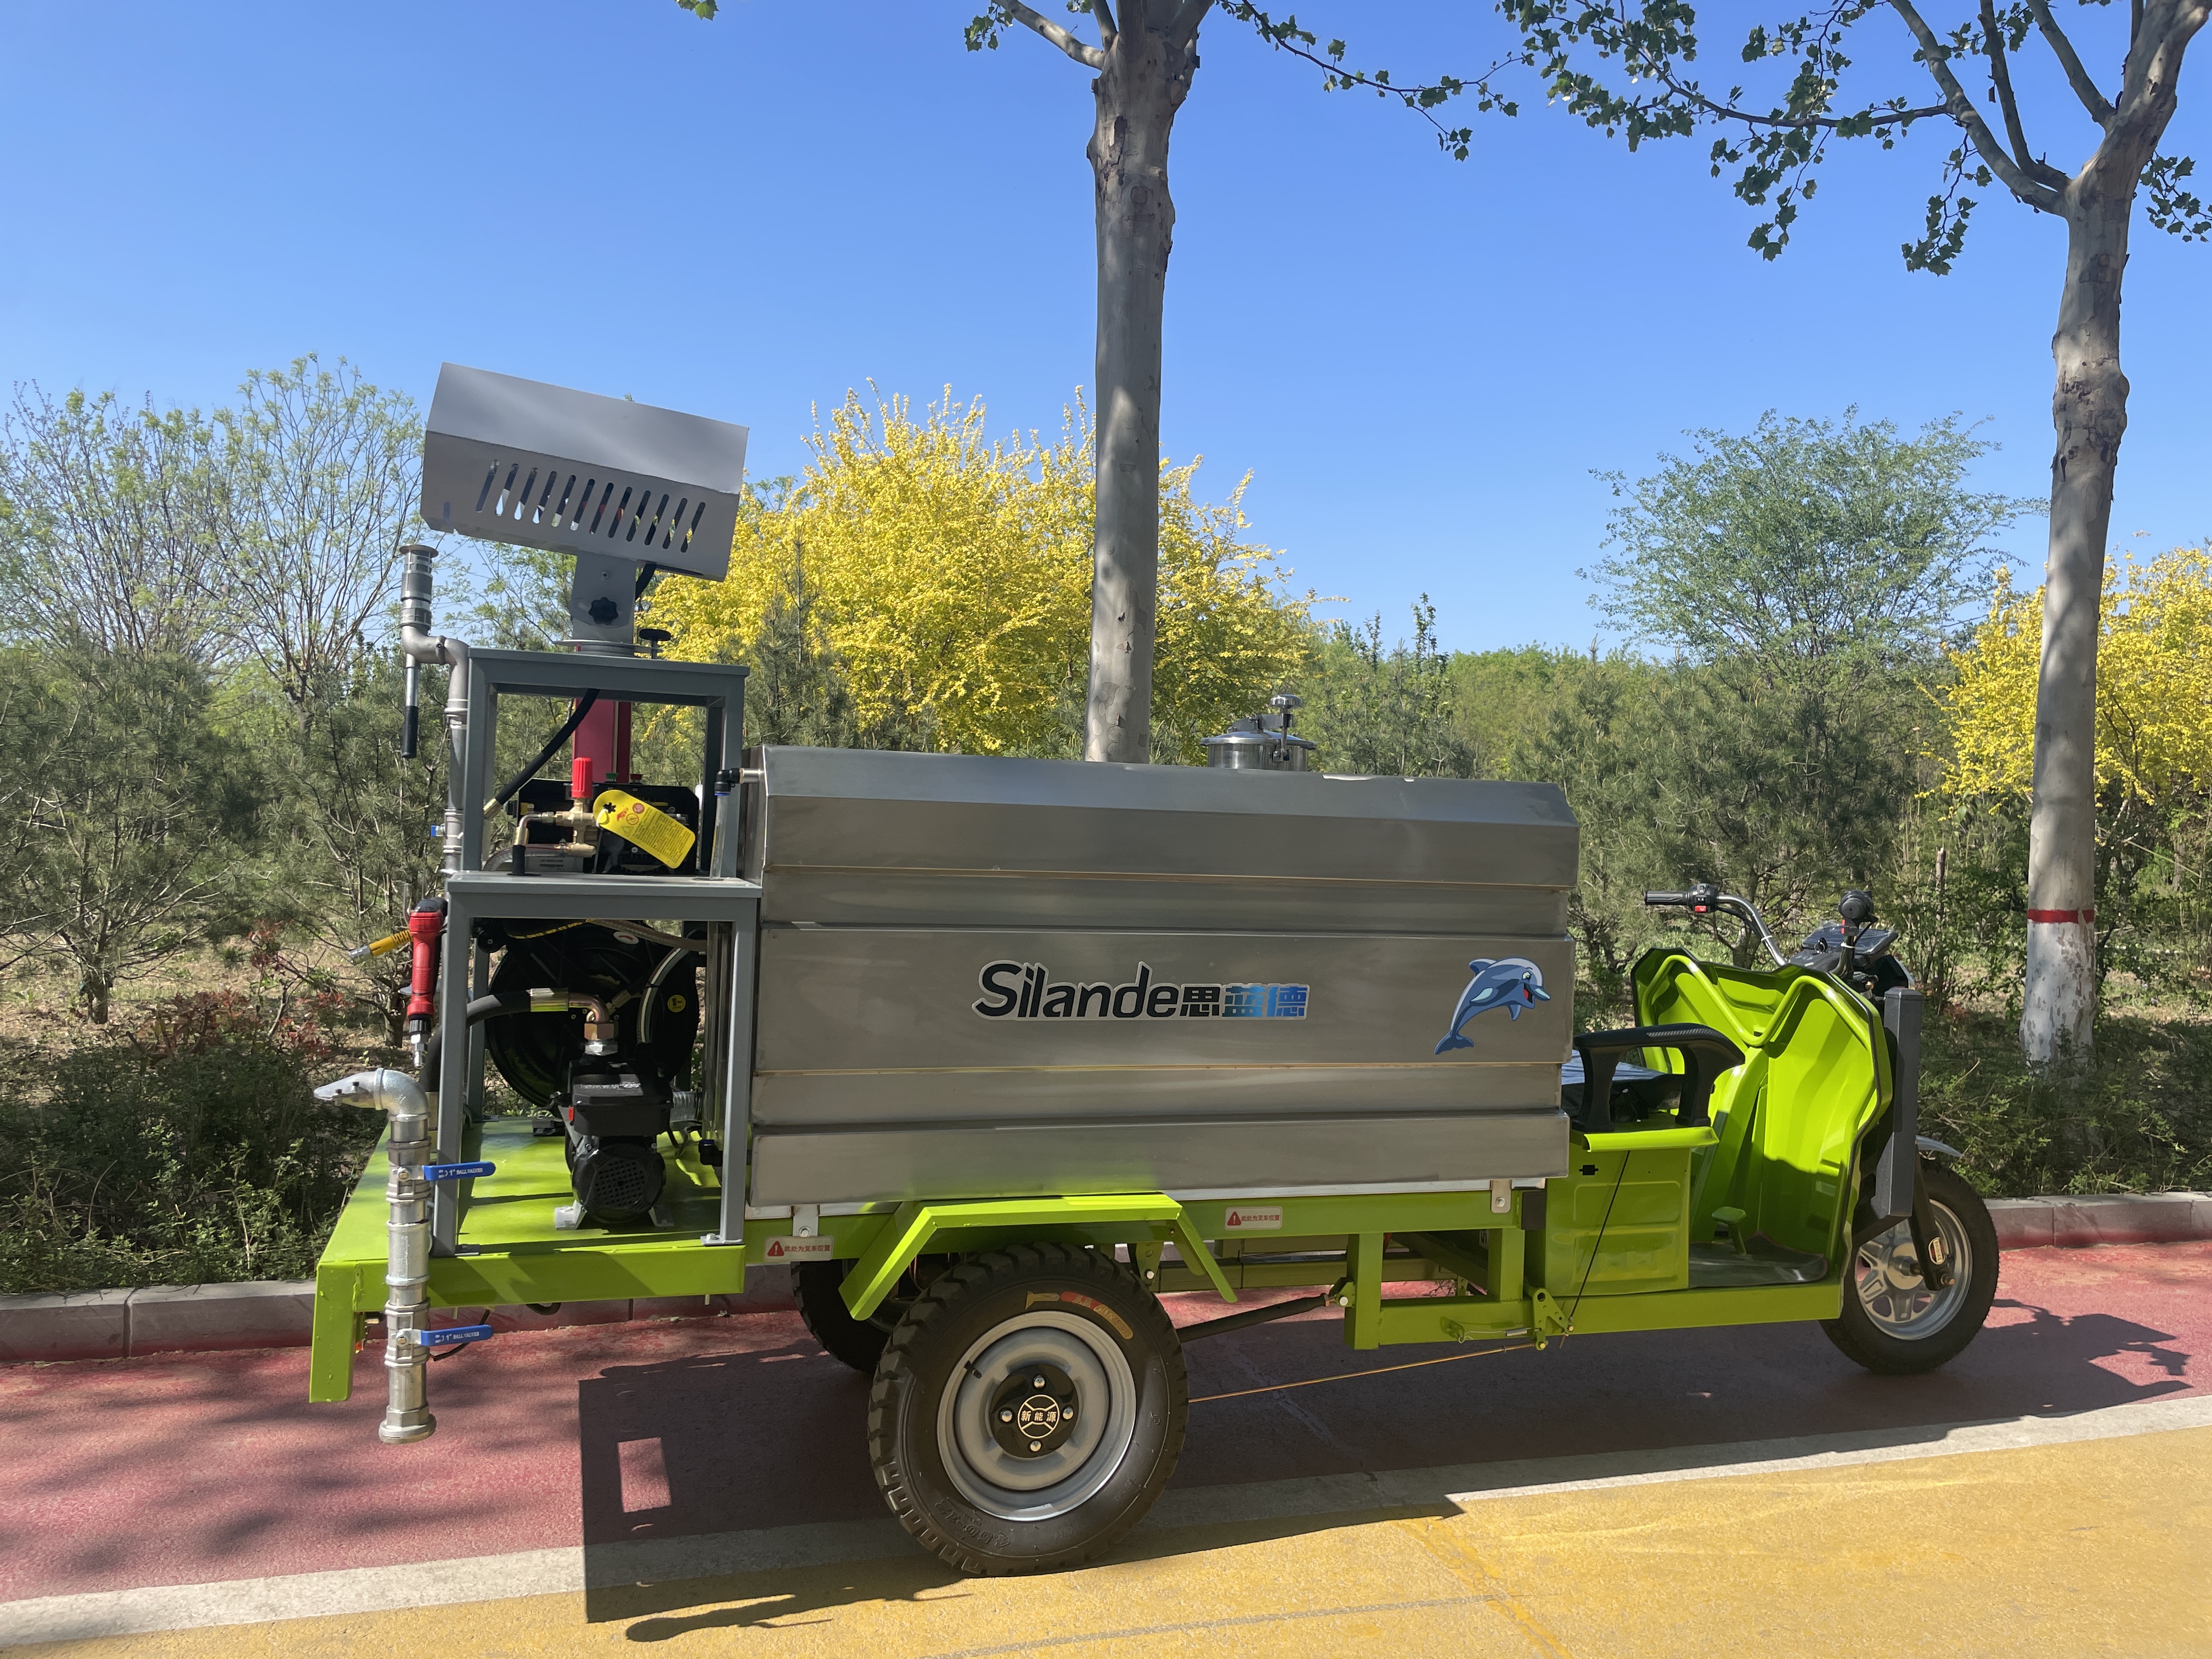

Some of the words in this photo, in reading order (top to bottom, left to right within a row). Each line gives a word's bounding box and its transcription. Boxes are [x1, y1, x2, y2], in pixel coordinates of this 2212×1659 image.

[975, 963, 1180, 1018] Silande
[1180, 985, 1308, 1018] 思蓝德
[783, 1244, 831, 1252] 此处为叉车位置
[1020, 1410, 1057, 1423] 新能源
